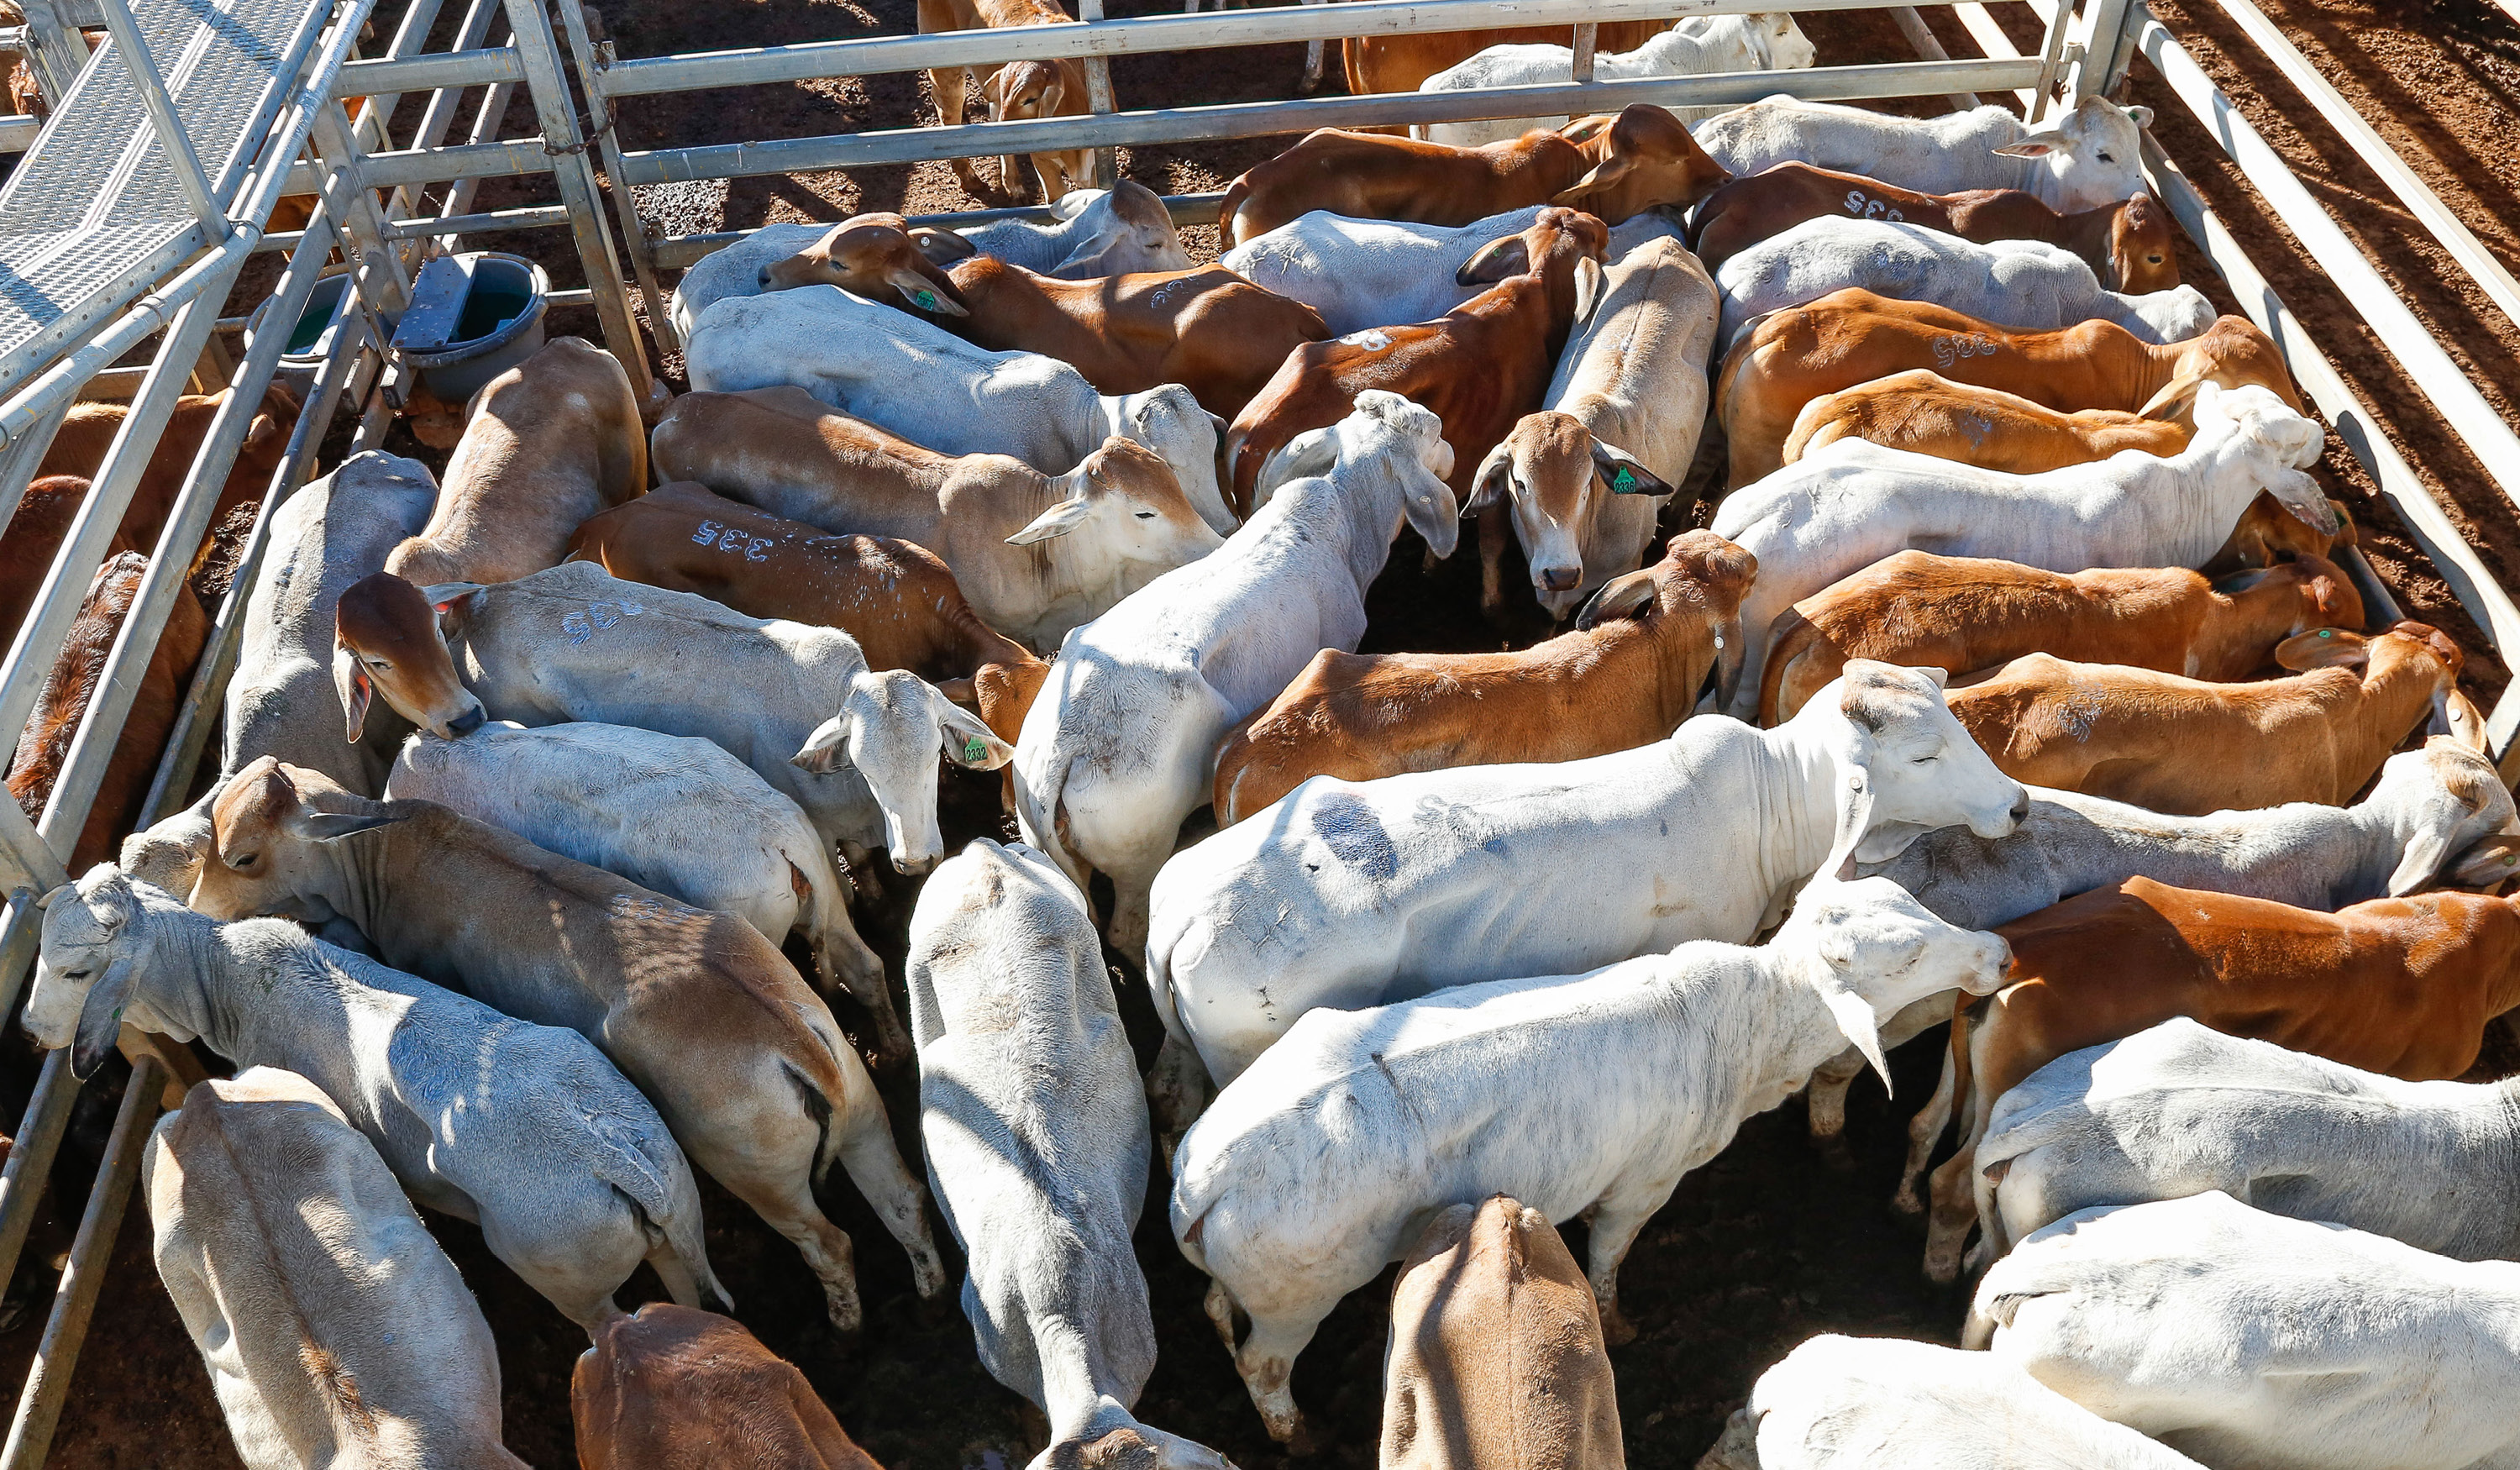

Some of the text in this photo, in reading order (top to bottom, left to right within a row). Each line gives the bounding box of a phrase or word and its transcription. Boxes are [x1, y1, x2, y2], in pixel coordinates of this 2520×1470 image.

[1615, 481, 1635, 494] 2336
[691, 519, 774, 562] 335
[967, 747, 987, 762] 2332
